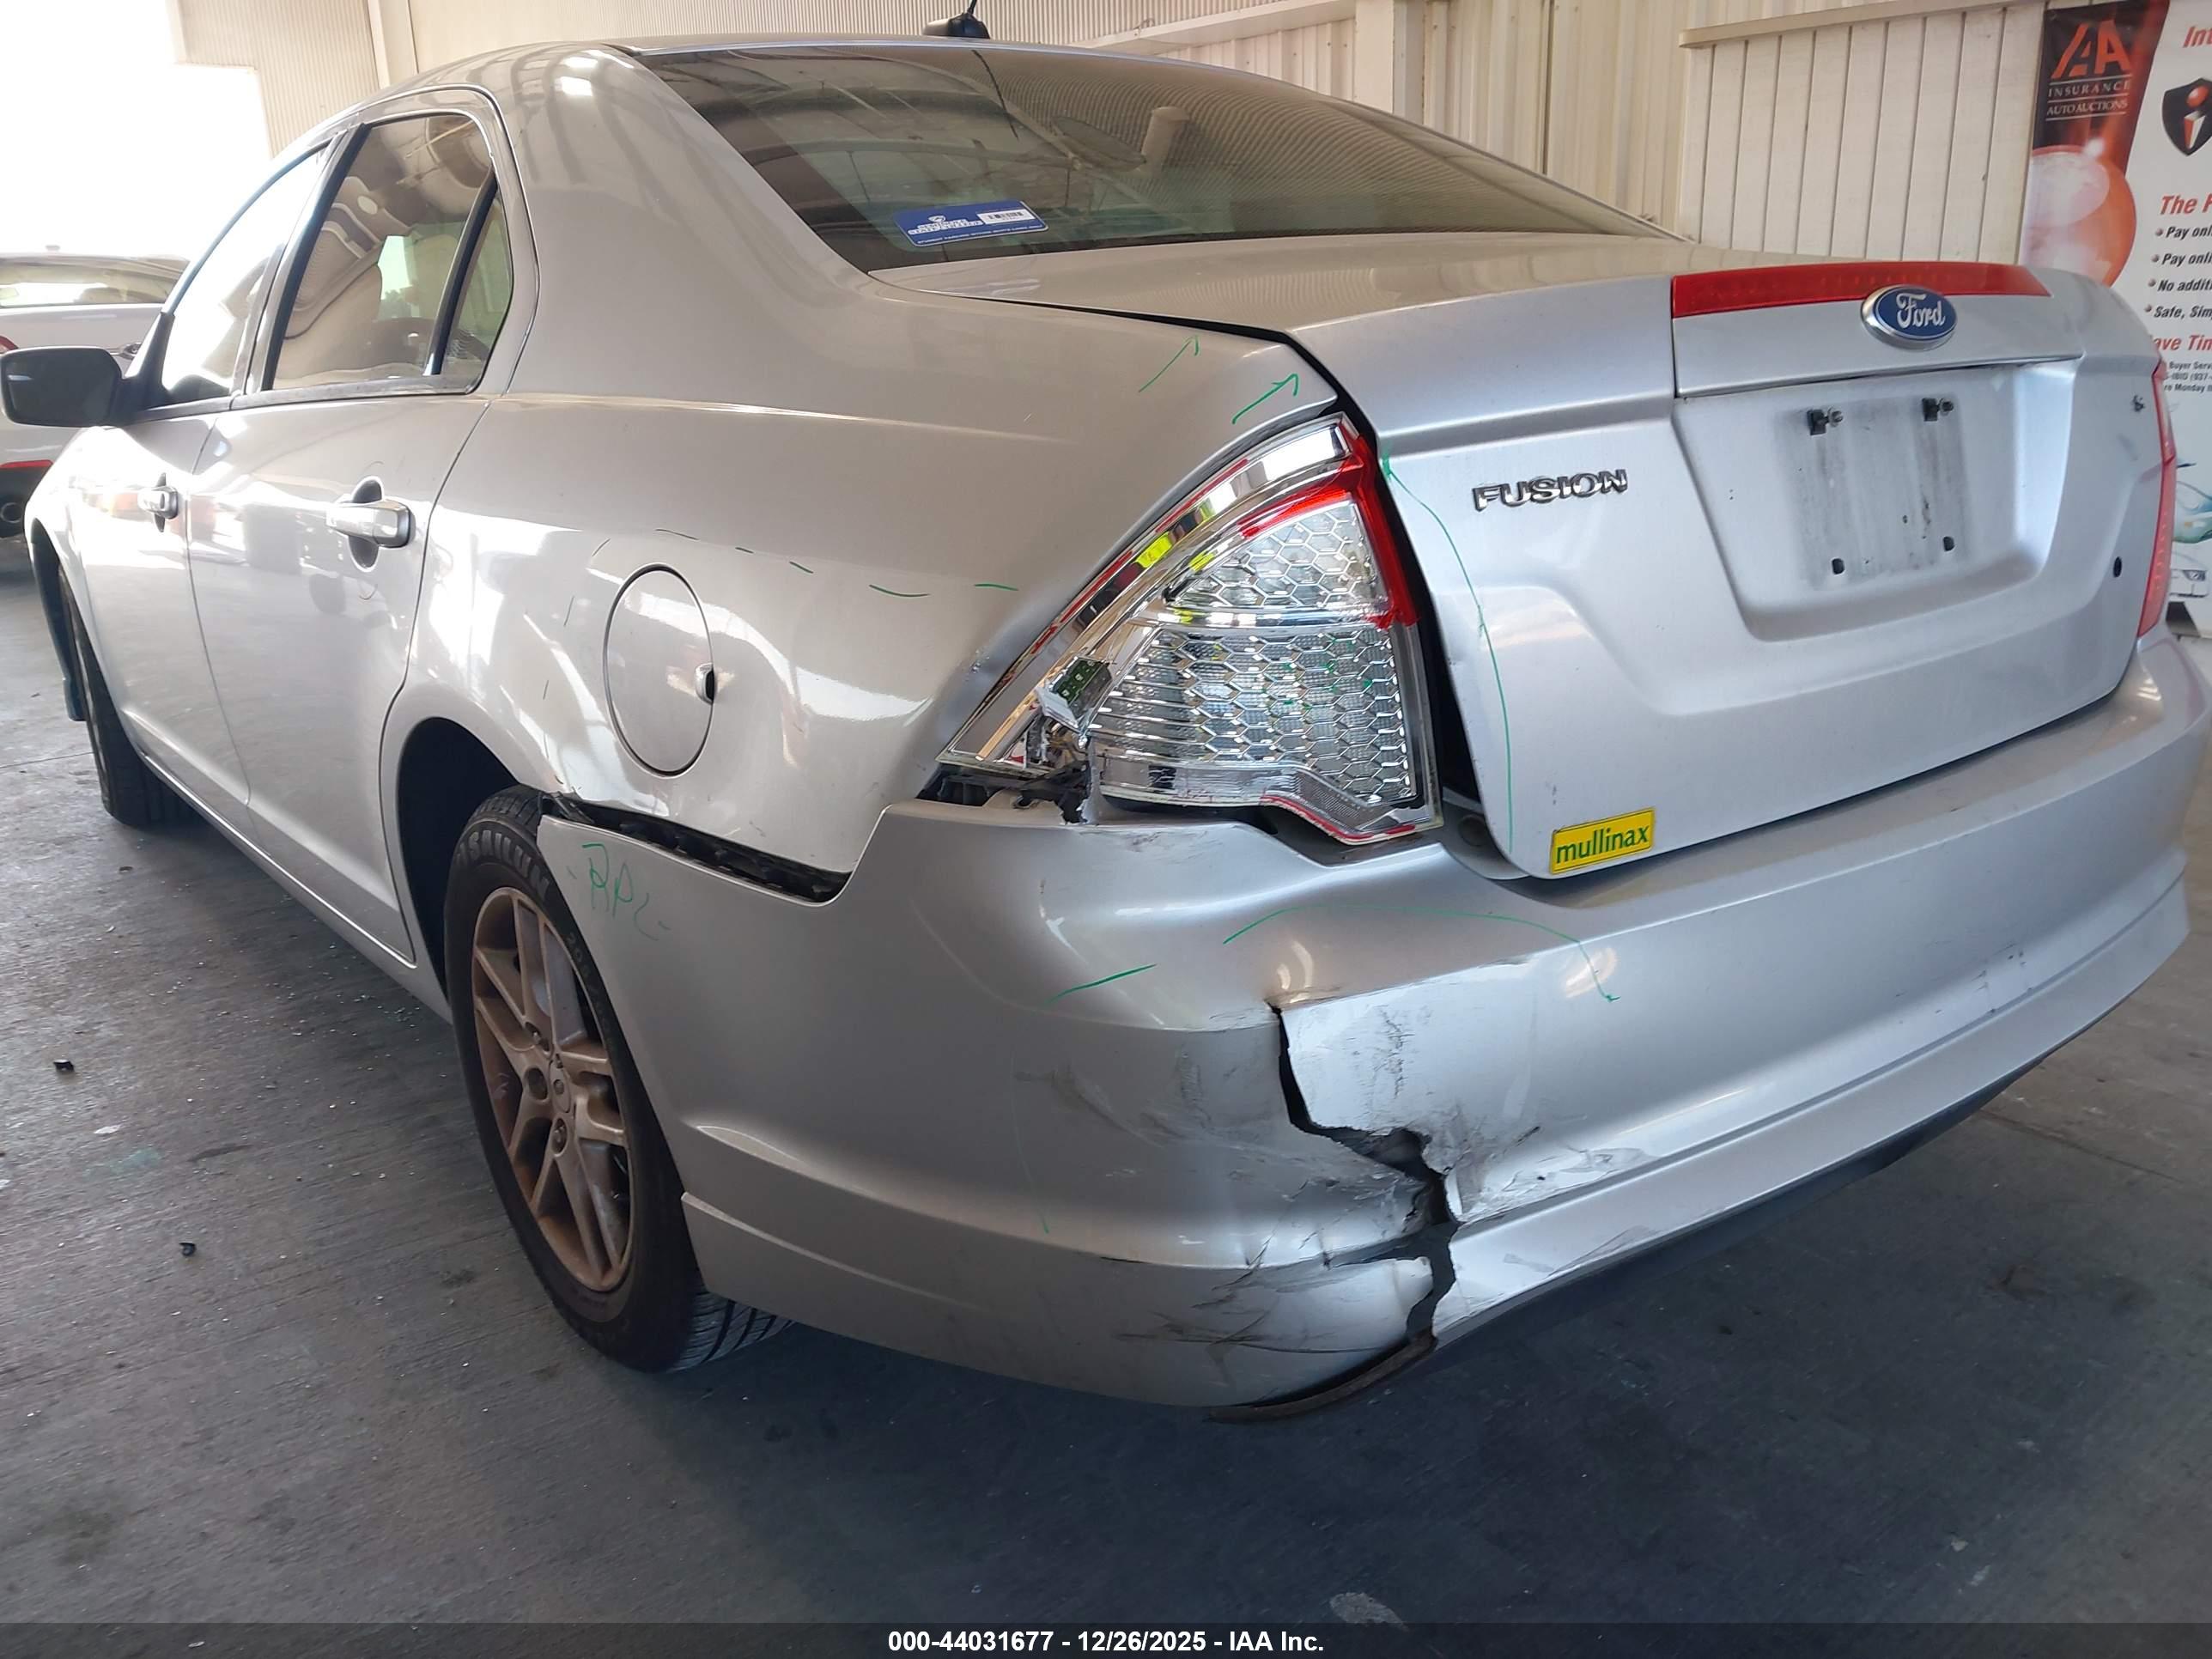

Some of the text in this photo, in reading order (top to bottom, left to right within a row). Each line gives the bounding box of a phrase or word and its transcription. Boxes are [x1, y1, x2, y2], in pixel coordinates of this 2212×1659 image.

[2048, 80, 2131, 97] INSURANCE
[2160, 194, 2198, 215] The
[2166, 224, 2212, 240] Pay onl
[2161, 252, 2186, 267] Pay
[2157, 279, 2174, 291] No
[1896, 293, 1946, 328] Ford
[2154, 305, 2212, 320] Safe, Sim
[2154, 337, 2182, 350] ave
[2174, 383, 2205, 393] Monday
[1473, 469, 1628, 512] FUSION
[1556, 825, 1650, 864] mullinax
[468, 830, 550, 902] SAILUN
